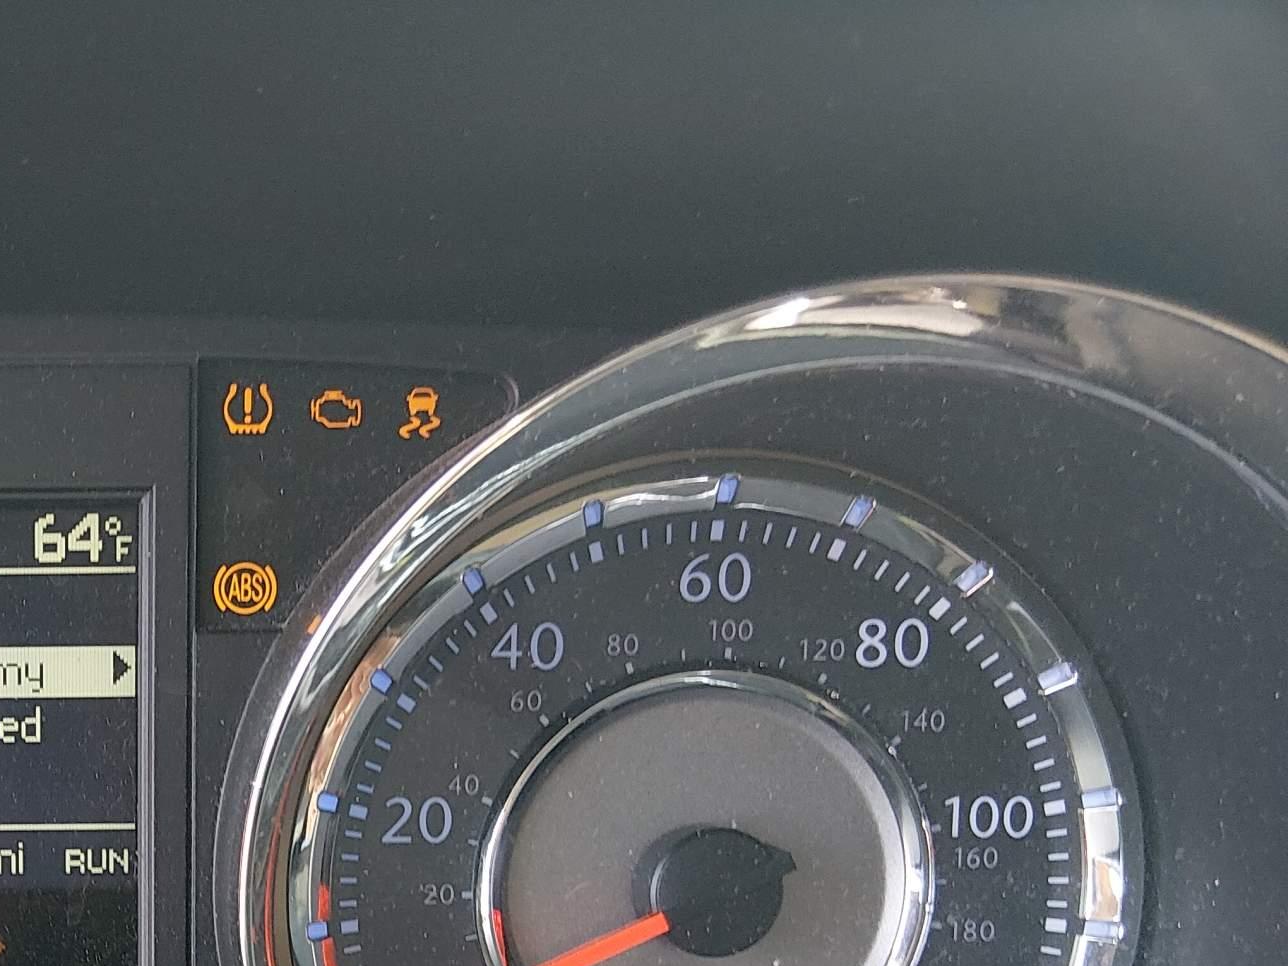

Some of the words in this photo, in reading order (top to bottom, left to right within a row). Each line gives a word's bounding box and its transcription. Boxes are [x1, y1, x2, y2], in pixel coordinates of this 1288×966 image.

[229, 574, 263, 602] ABS
[680, 553, 752, 601] 60
[709, 619, 753, 642] 100
[491, 622, 563, 670] 40
[608, 634, 639, 656] 80
[801, 639, 844, 662] 120
[854, 619, 928, 668] 80
[510, 691, 542, 712] 60
[903, 711, 945, 733] 140
[448, 774, 480, 796] 40
[381, 796, 451, 844] 20
[946, 796, 1033, 839] 100
[65, 848, 130, 874] RUN
[954, 847, 998, 869] 160
[423, 883, 454, 904] 20
[951, 919, 994, 942] 180
